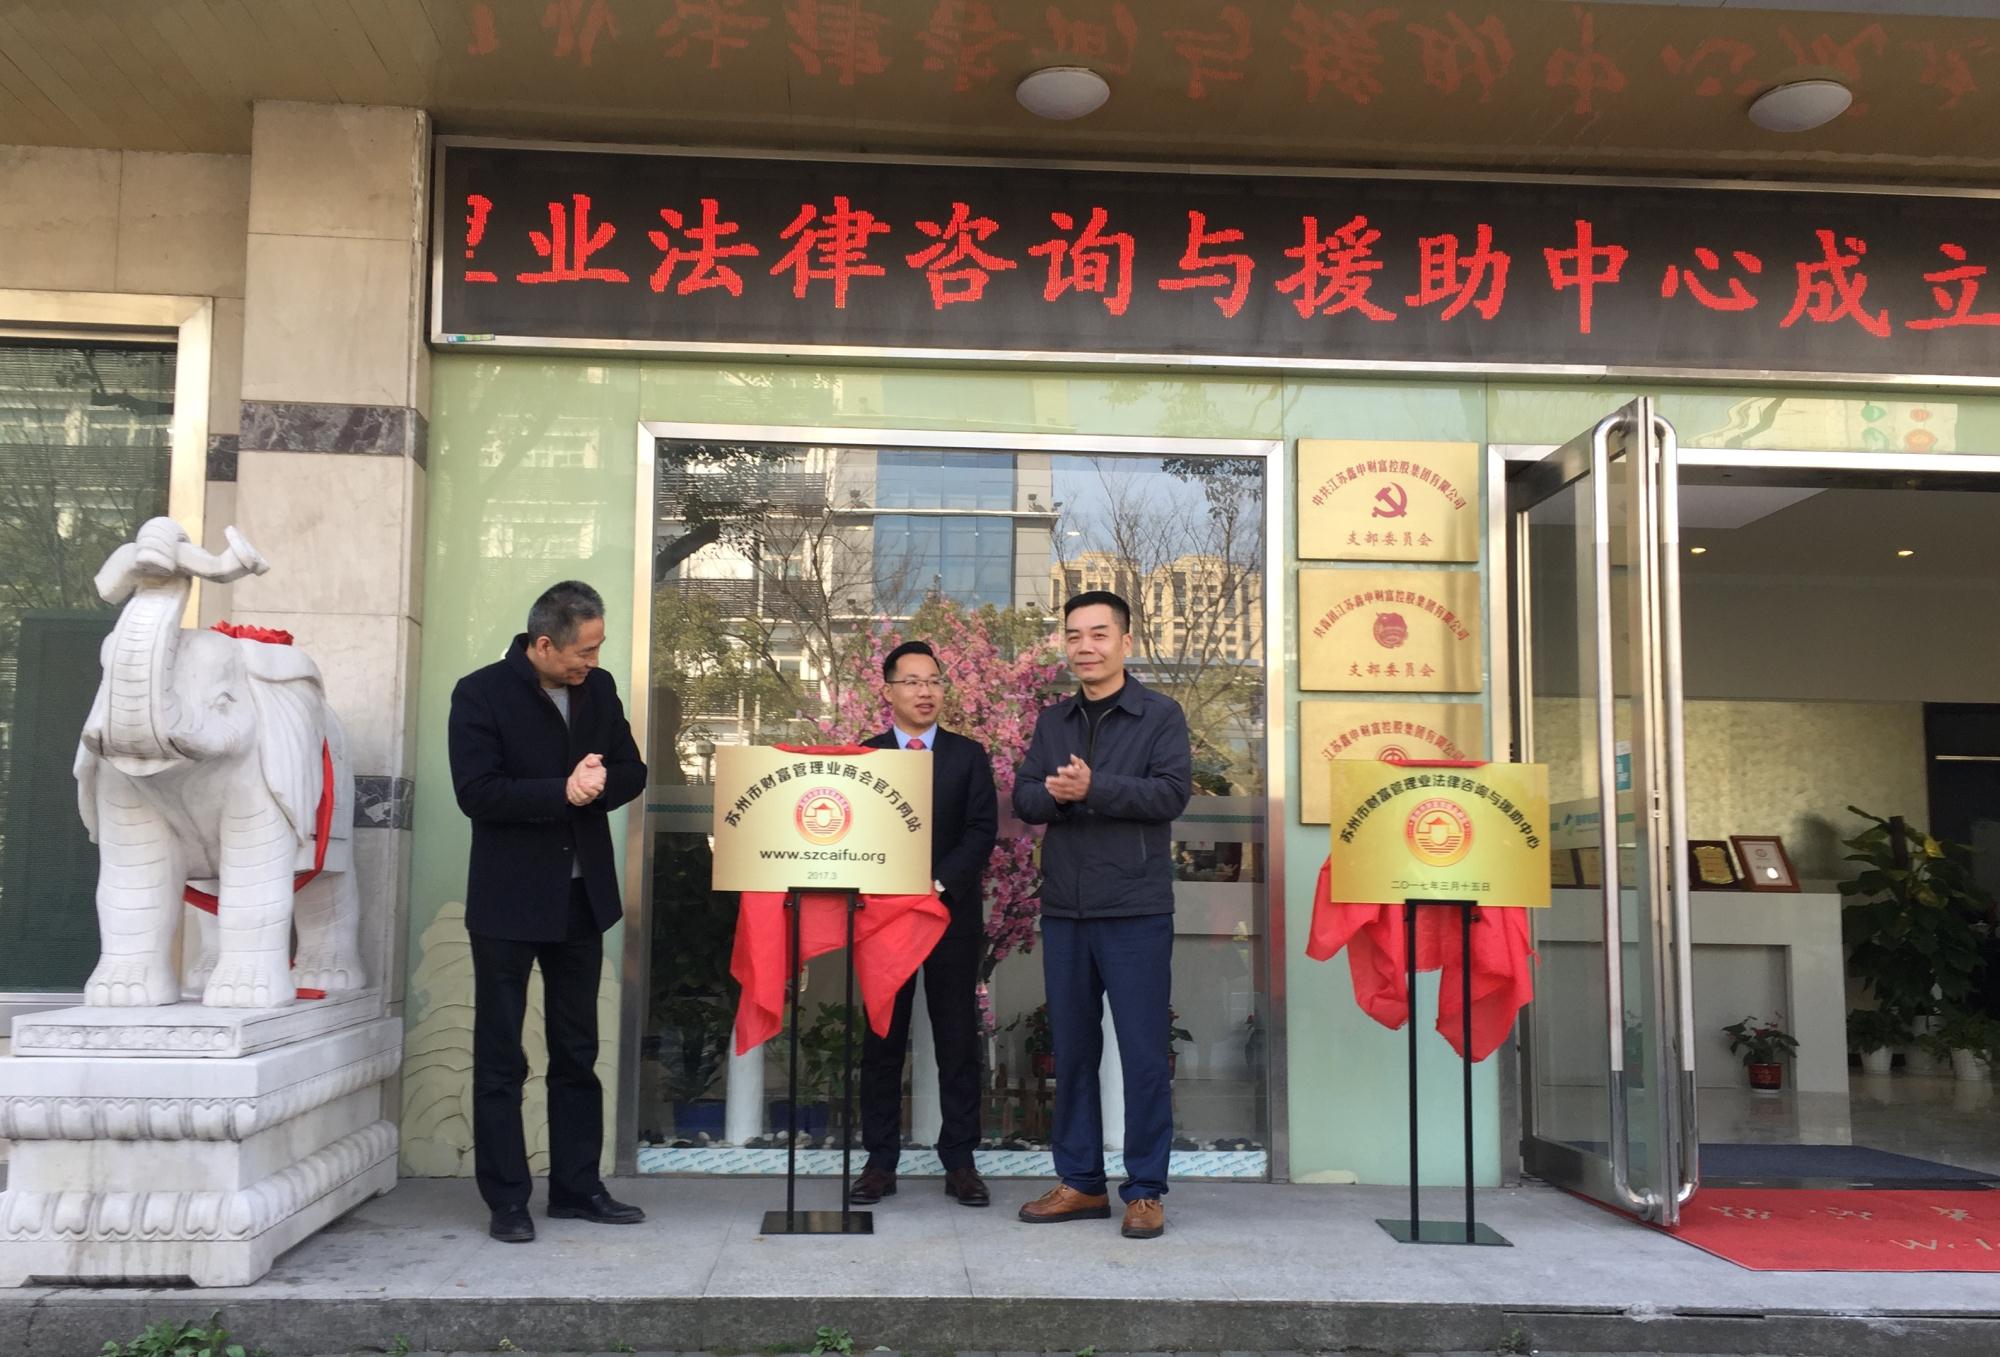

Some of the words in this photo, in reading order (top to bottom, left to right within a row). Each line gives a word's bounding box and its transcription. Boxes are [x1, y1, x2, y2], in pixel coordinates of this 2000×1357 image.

[464, 192, 2000, 339] 业法律咨询与援助中心成立
[1346, 530, 1433, 547] 支部委员会
[1347, 661, 1435, 678] 支部委员会
[725, 760, 921, 833] 苏州市财富管理业商会官方网站
[1339, 774, 1540, 850] 苏州市财富管理业法律咨询与援助中心
[760, 848, 886, 864] www.szcaifu.org
[807, 871, 837, 881] 2017.3
